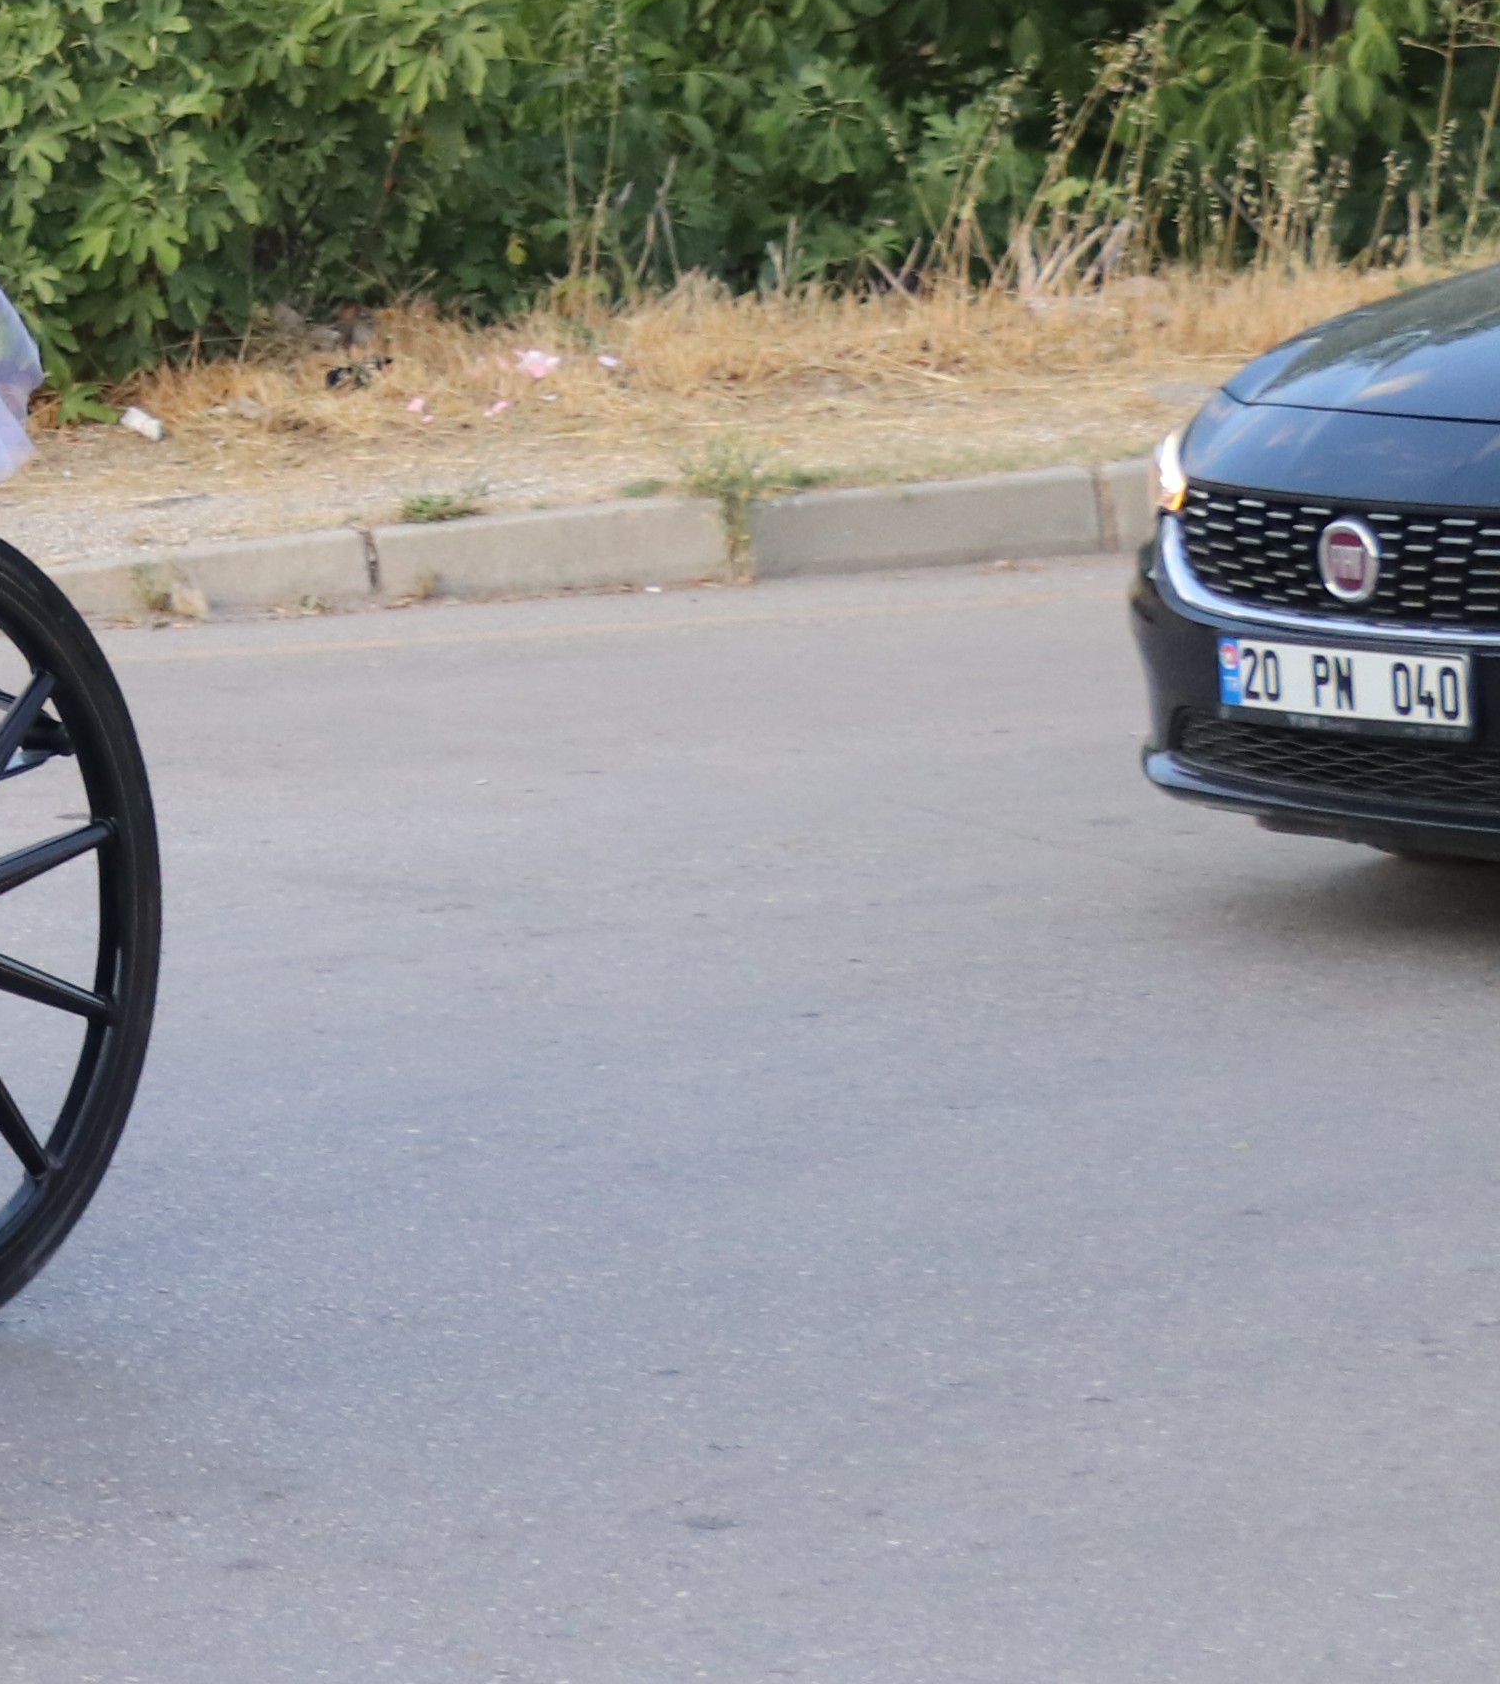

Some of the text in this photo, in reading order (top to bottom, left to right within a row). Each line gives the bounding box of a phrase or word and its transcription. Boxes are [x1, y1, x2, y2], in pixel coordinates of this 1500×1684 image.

[1242, 648, 1459, 720] 20 PN 040
